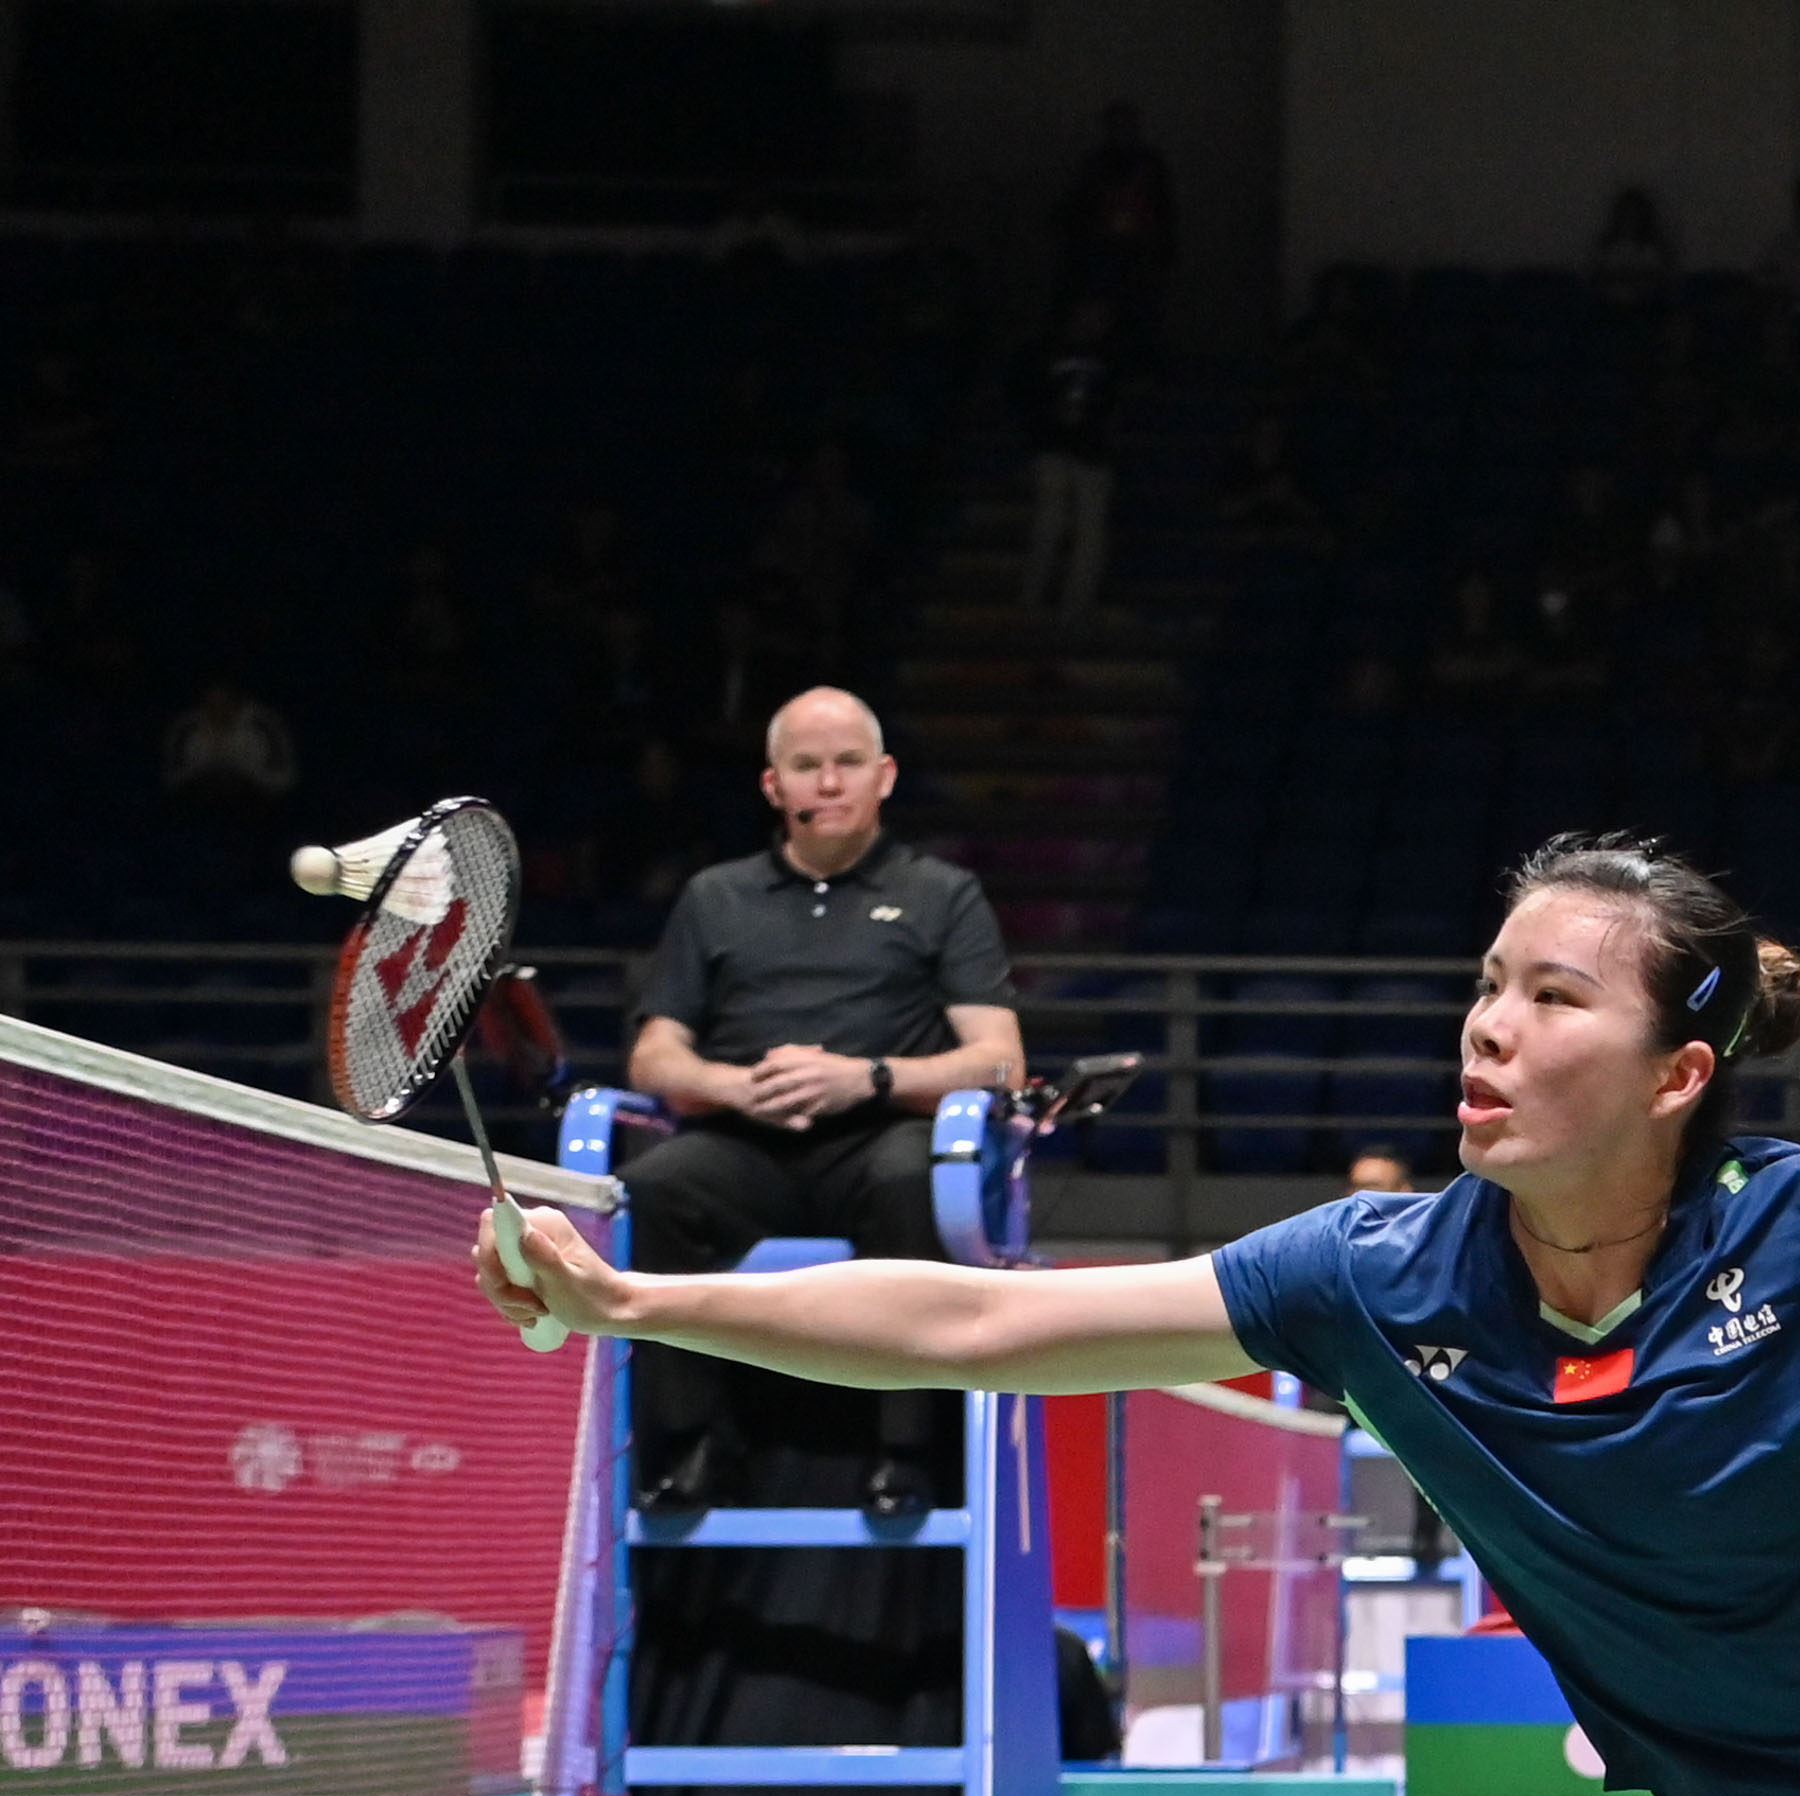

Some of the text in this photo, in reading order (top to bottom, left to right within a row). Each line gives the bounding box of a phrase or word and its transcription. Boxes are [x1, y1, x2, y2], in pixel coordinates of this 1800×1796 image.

[1708, 1303, 1777, 1347] 中国电信
[0, 1660, 290, 1769] ONEX
